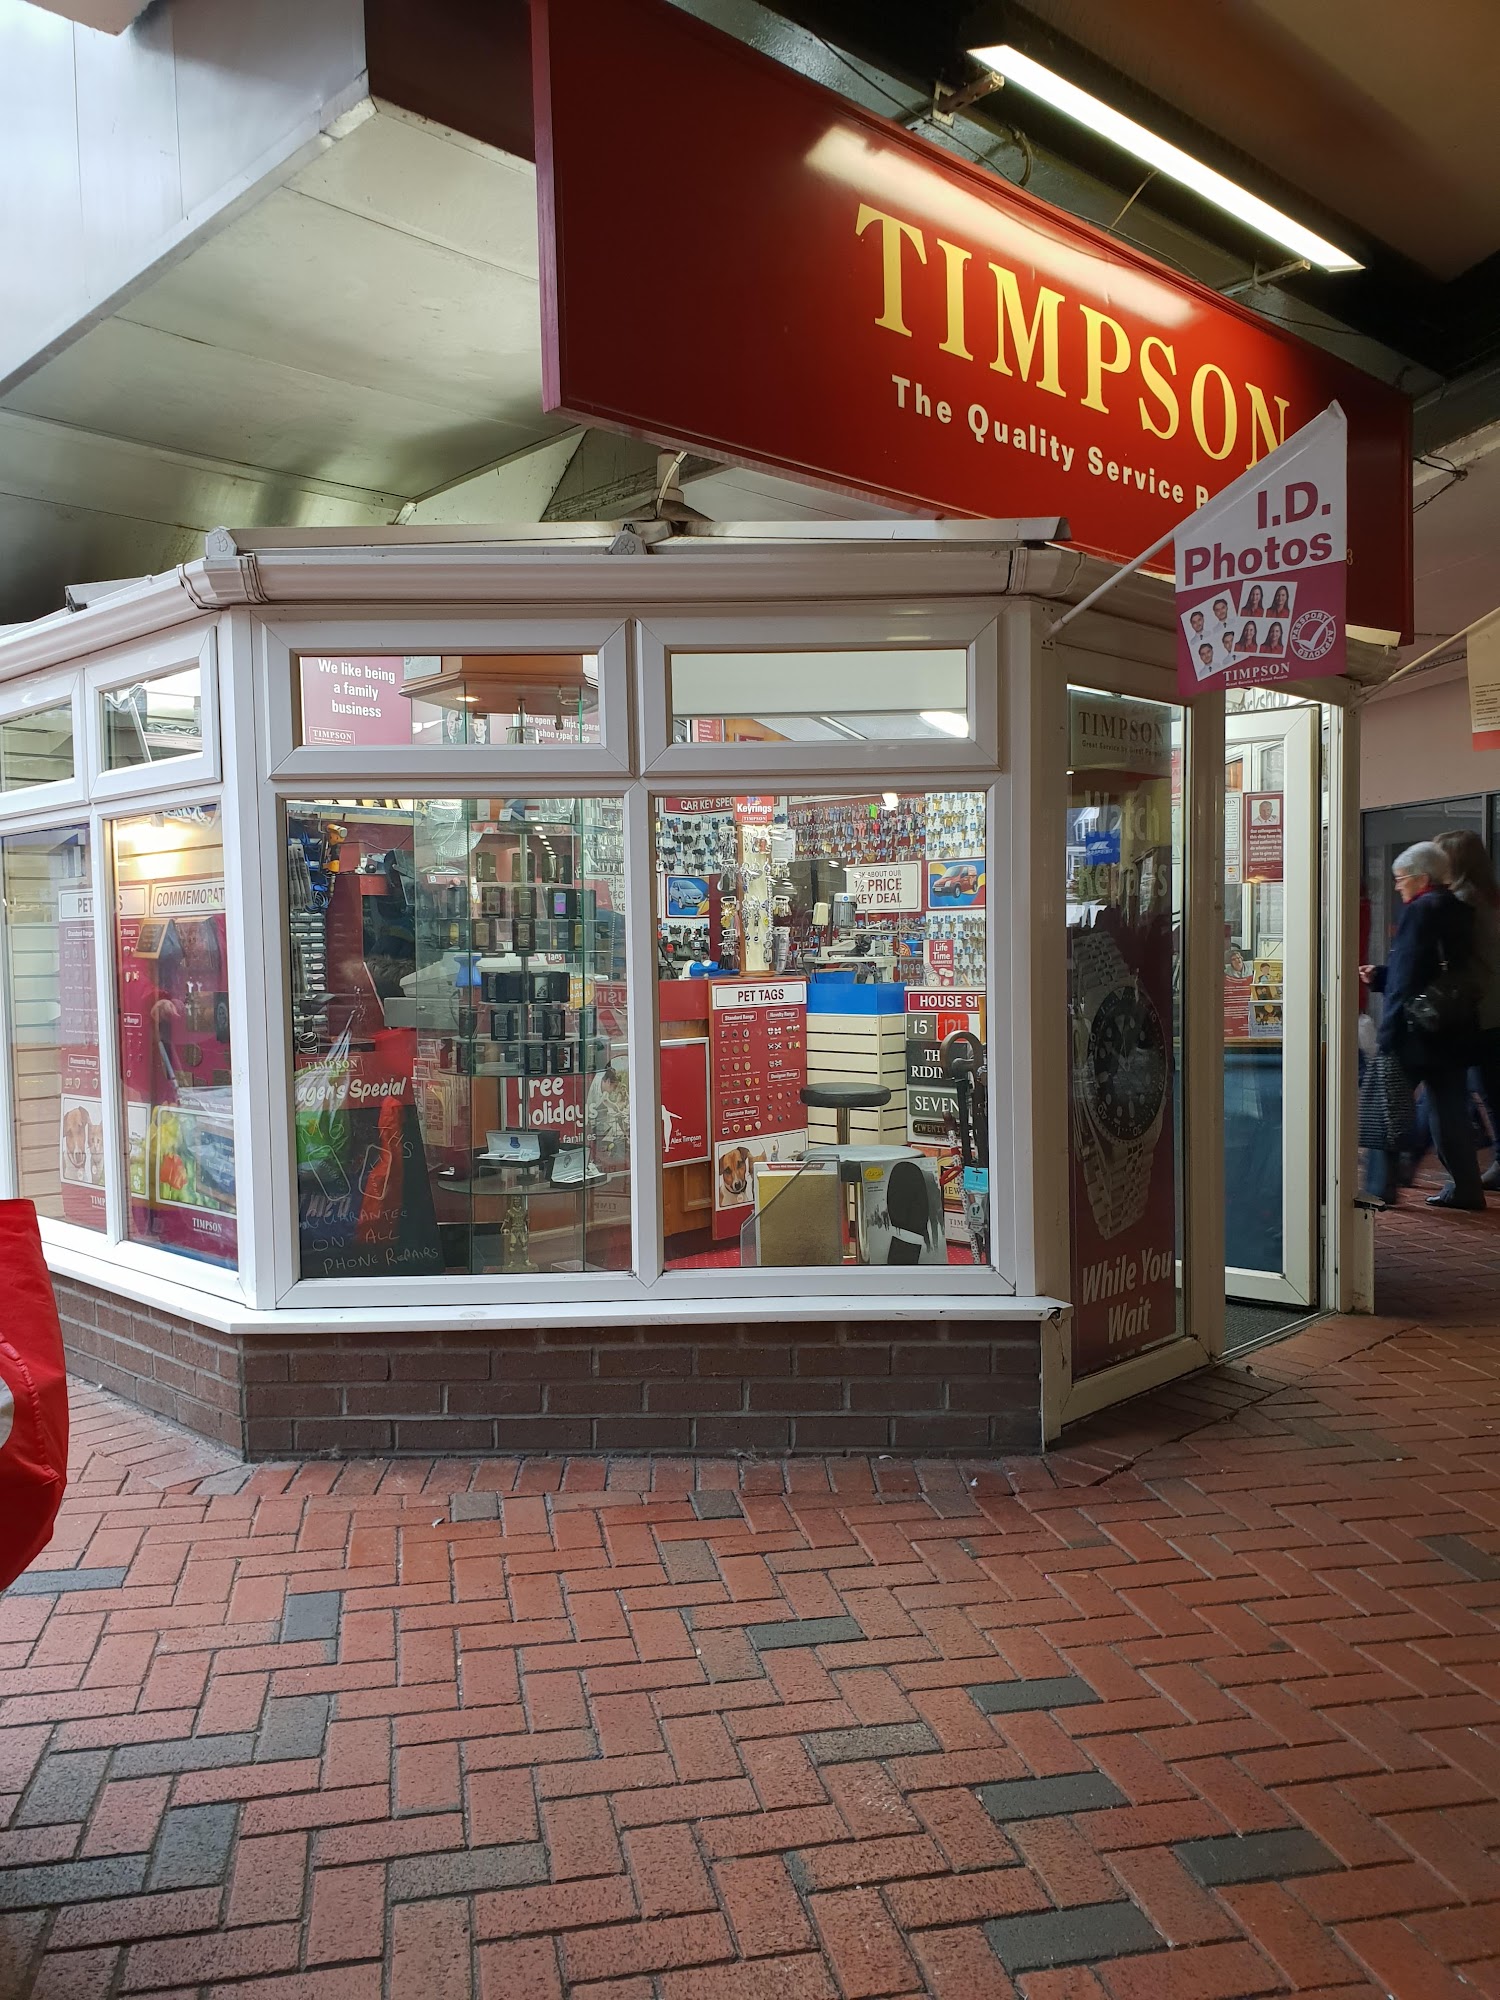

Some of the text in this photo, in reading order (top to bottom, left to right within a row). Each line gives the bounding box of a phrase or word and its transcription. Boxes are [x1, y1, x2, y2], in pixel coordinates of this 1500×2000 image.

[855, 202, 1290, 470] TIMPSON
[892, 374, 953, 424] The
[967, 402, 1075, 472] Quality
[1088, 446, 1184, 504] Service
[1256, 481, 1331, 530] I.D.
[1184, 532, 1333, 587] Photos
[1291, 611, 1329, 640] PASSPORT
[1297, 629, 1335, 659] APPROVED
[318, 659, 396, 685] We like being
[1222, 662, 1291, 682] TIMPSON
[333, 681, 379, 702] a family
[331, 699, 382, 718] business
[534, 717, 552, 726] open
[564, 719, 576, 729] first
[1078, 711, 1166, 746] TIMPSON
[312, 729, 353, 741] TIMPSON
[539, 728, 555, 738] shoe
[680, 799, 699, 811] CAR
[700, 798, 715, 810] KEY
[736, 803, 773, 815] Keyrings
[1083, 789, 1161, 841] Watch
[867, 870, 887, 878] ABOUT
[867, 878, 902, 892] PRICE
[156, 887, 224, 907] COMMEMORAT
[856, 892, 903, 905] KEY DEAL
[77, 897, 93, 914] PET
[932, 951, 951, 960] Time
[935, 943, 949, 952] Life
[737, 988, 785, 1003] PET TAGS
[919, 995, 962, 1008] HOUSE
[724, 1013, 755, 1022] Standard Range
[913, 1019, 928, 1035] 15
[943, 1018, 961, 1036] 121
[923, 1049, 941, 1062] TH
[304, 1059, 359, 1071] TIMPSON
[770, 1072, 786, 1080] Designer
[349, 1076, 407, 1104] Special
[744, 1108, 757, 1116] Range
[914, 1095, 960, 1113] SEVEN
[562, 1131, 597, 1144] familes
[670, 1135, 702, 1145] Alex Timpson
[192, 1217, 223, 1233] TIMPSON
[312, 1228, 400, 1252] ON ALL
[323, 1252, 379, 1275] PHONE
[1082, 1247, 1173, 1306] While You
[1108, 1296, 1152, 1345] Wait
